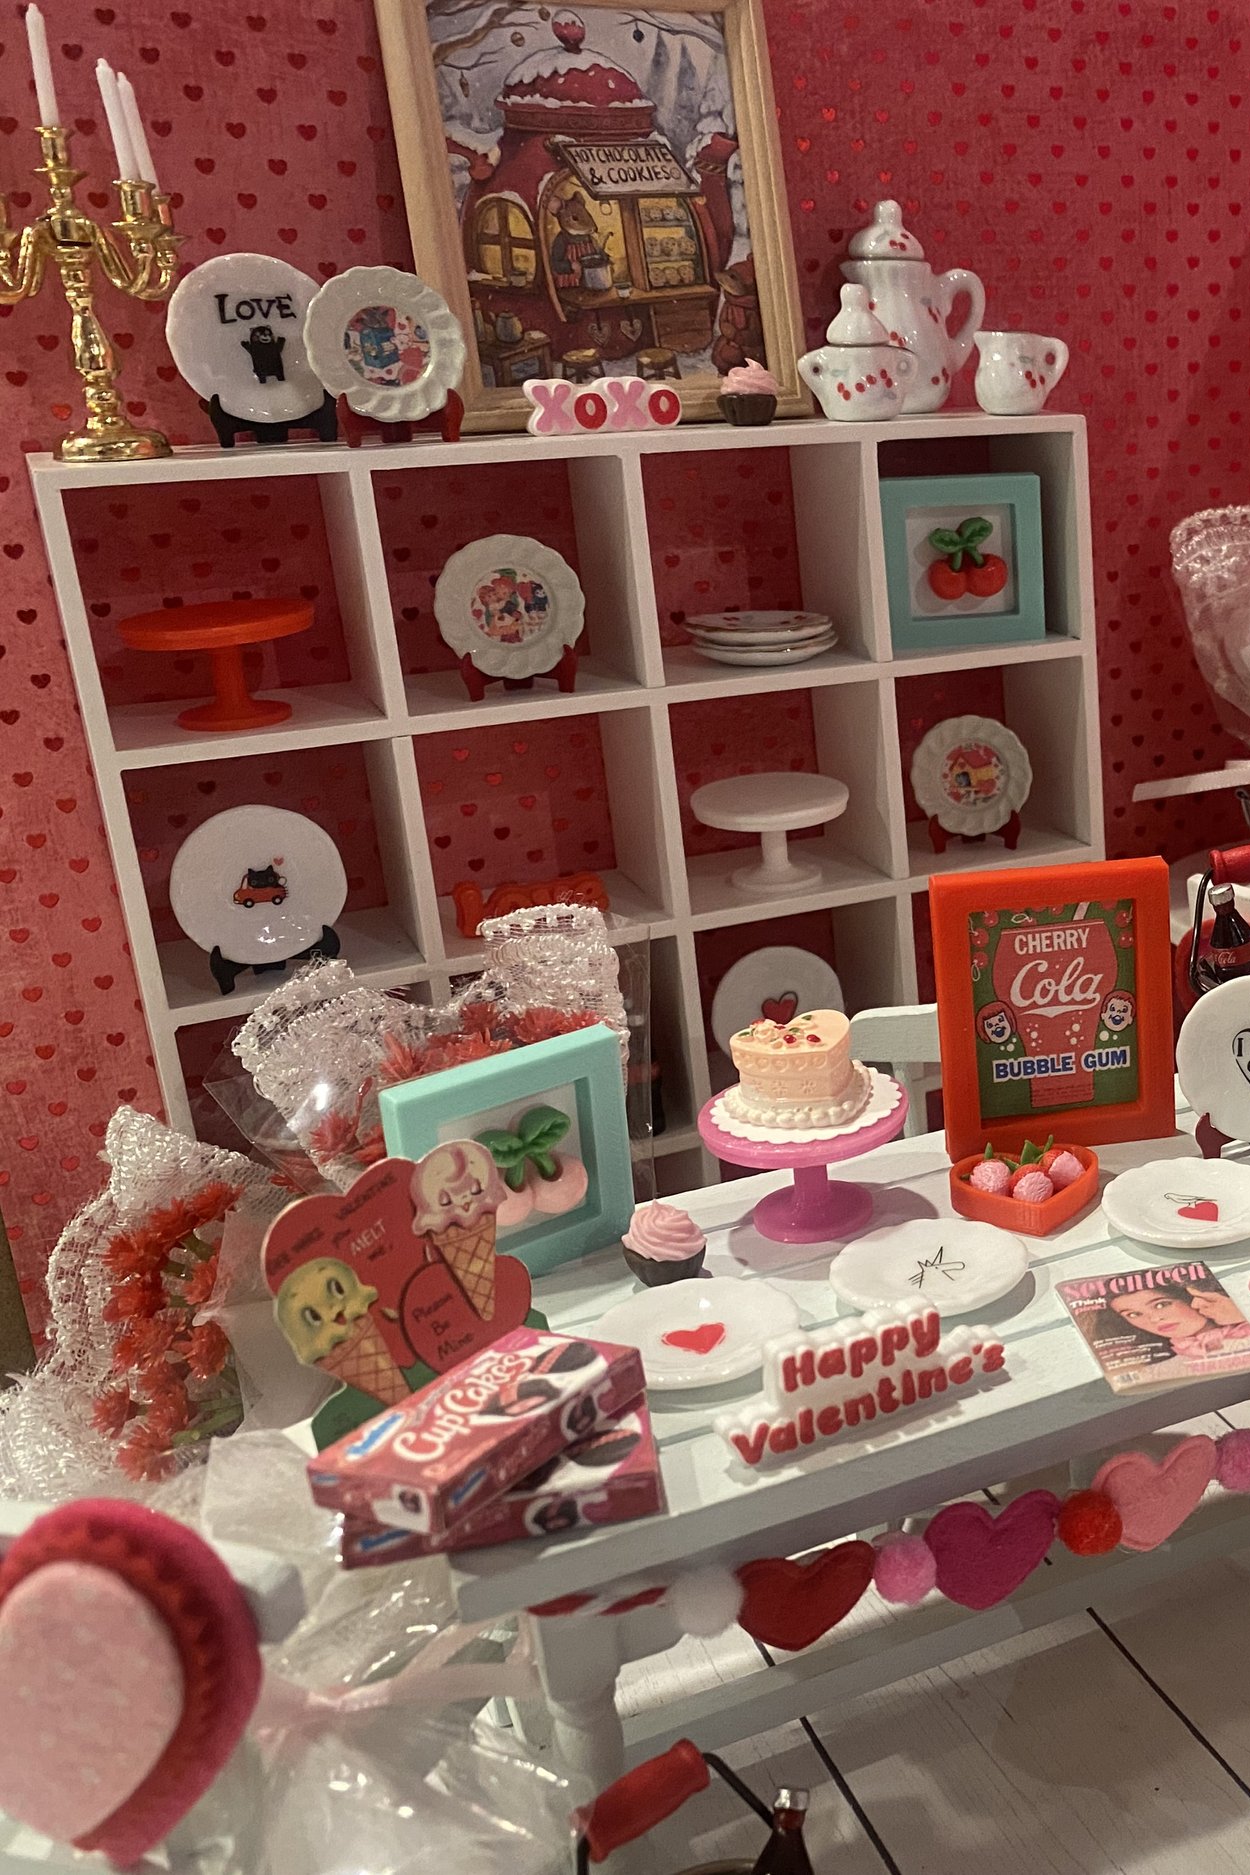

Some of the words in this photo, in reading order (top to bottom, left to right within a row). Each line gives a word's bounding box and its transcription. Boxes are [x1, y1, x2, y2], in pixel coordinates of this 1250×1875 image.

[572, 148, 597, 164] HOT
[596, 146, 673, 164] CHOCOLATE
[590, 167, 607, 186] &
[607, 164, 671, 184] COOKIES
[214, 293, 297, 325] LOVE
[531, 380, 681, 433] XOXO
[1014, 927, 1090, 955] CHERRY
[1010, 956, 1104, 1012] Cola
[1236, 1037, 1244, 1057] I
[994, 1053, 1074, 1080] BUBBLE
[1082, 1049, 1128, 1070] GUM
[350, 1218, 387, 1256] MELT
[1069, 1296, 1107, 1309] Think
[437, 1332, 474, 1361] Mine
[781, 1311, 941, 1393] Happy
[730, 1343, 1005, 1465] Valentine's
